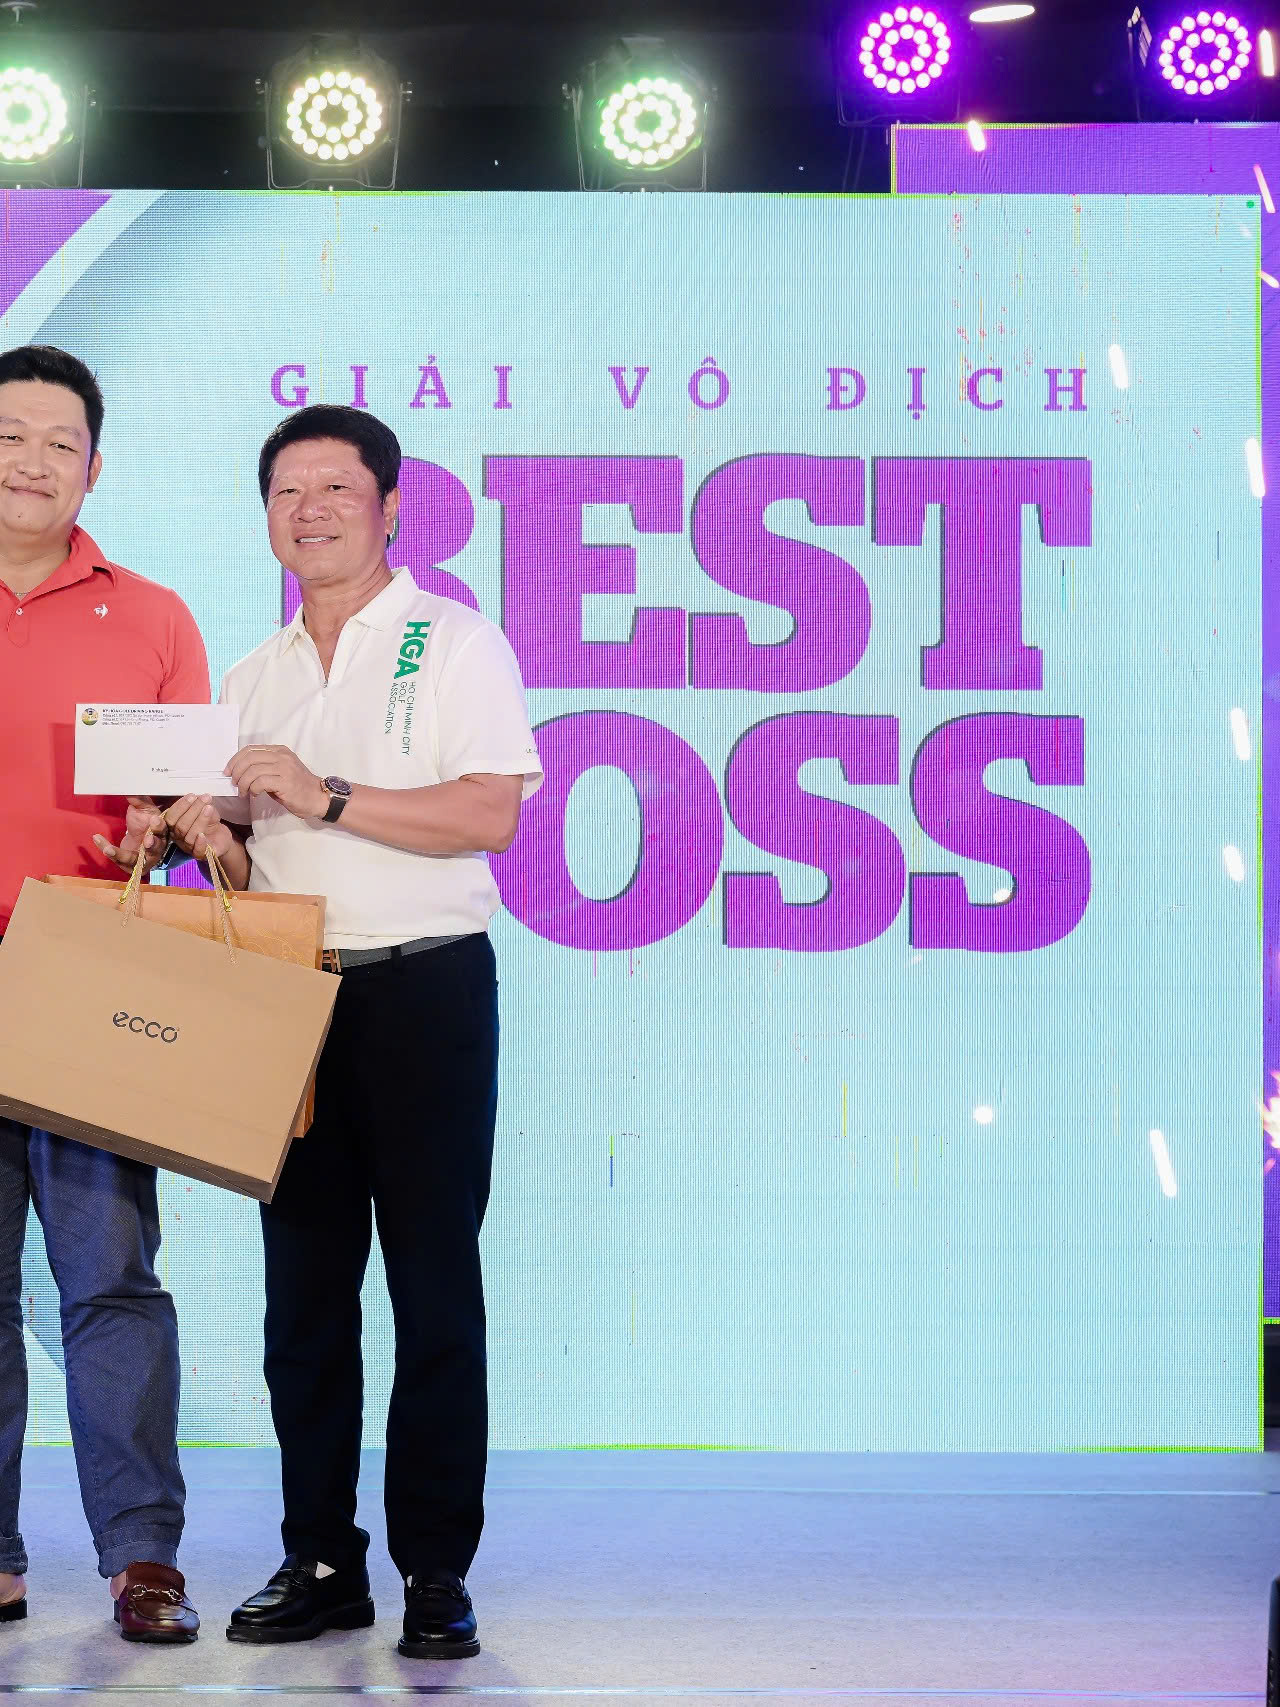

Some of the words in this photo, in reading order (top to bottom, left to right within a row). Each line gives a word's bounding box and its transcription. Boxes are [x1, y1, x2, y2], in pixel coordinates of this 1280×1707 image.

[271, 354, 513, 409] GIẢI
[608, 355, 730, 411] VÔ
[826, 366, 1087, 421] ĐỊCH
[281, 452, 1093, 692] EST
[393, 620, 431, 679] HGA
[384, 682, 399, 735] ASSOCIATION
[398, 681, 408, 704] GOLF
[406, 696, 415, 711] CHI
[403, 712, 414, 734] MINH
[402, 736, 411, 756] CITY
[112, 1011, 178, 1043] ecco
